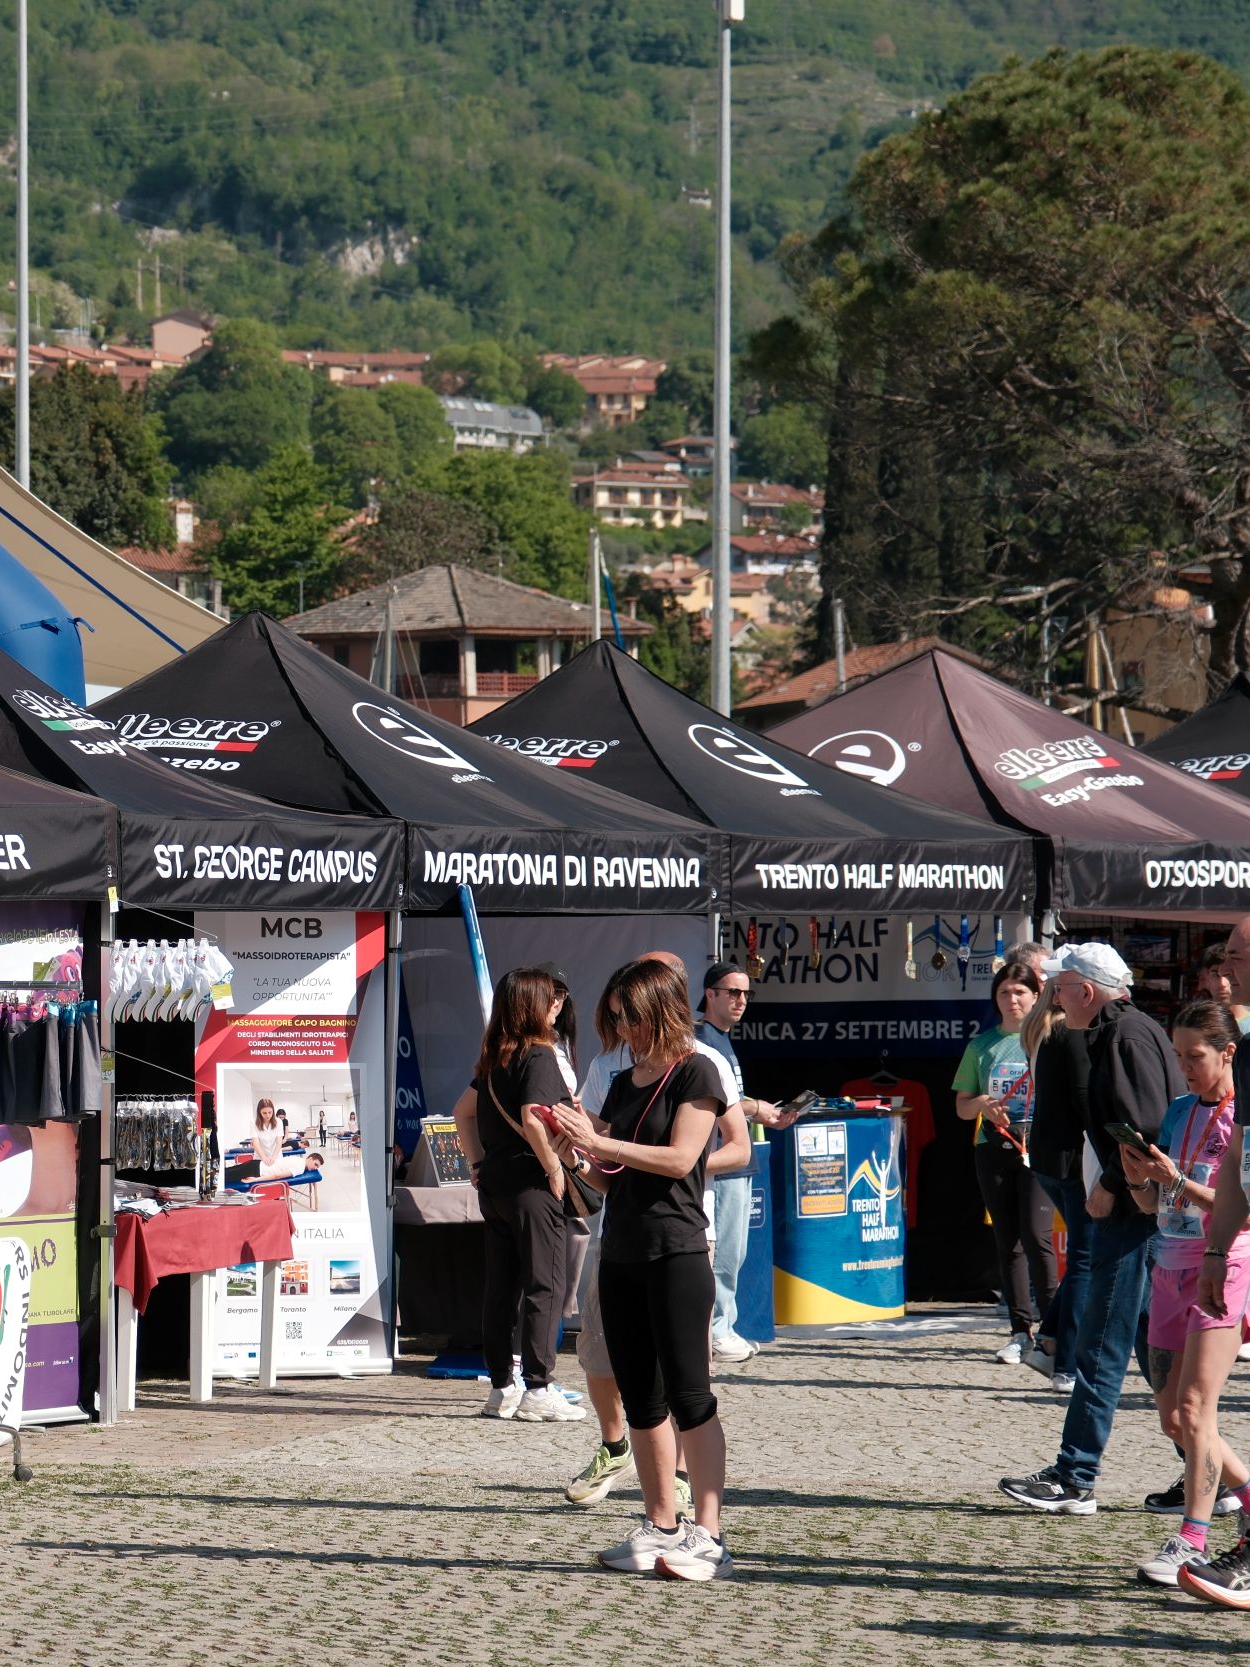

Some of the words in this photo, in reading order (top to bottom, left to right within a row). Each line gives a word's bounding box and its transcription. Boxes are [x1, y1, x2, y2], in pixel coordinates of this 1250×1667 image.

[194, 845, 283, 880] GEORGE
[287, 850, 377, 883] CAMPUS
[424, 850, 557, 885] MARATONA
[564, 855, 587, 886] DI
[594, 856, 700, 888] RAVENNA
[755, 863, 839, 889] TRENTO
[844, 863, 893, 889] HALF
[899, 863, 1004, 890] MARATHON
[261, 917, 323, 938] MCB
[972, 964, 993, 975] TRE
[272, 977, 290, 987] TUA
[294, 977, 332, 987] NUOVA
[802, 1022, 828, 1040] 27
[835, 1020, 963, 1040] SETTEMBRE
[852, 1198, 880, 1213] TRENTO
[862, 1212, 880, 1227] HALF
[304, 1228, 345, 1239] ITALIA
[227, 1307, 258, 1315] Bergamo
